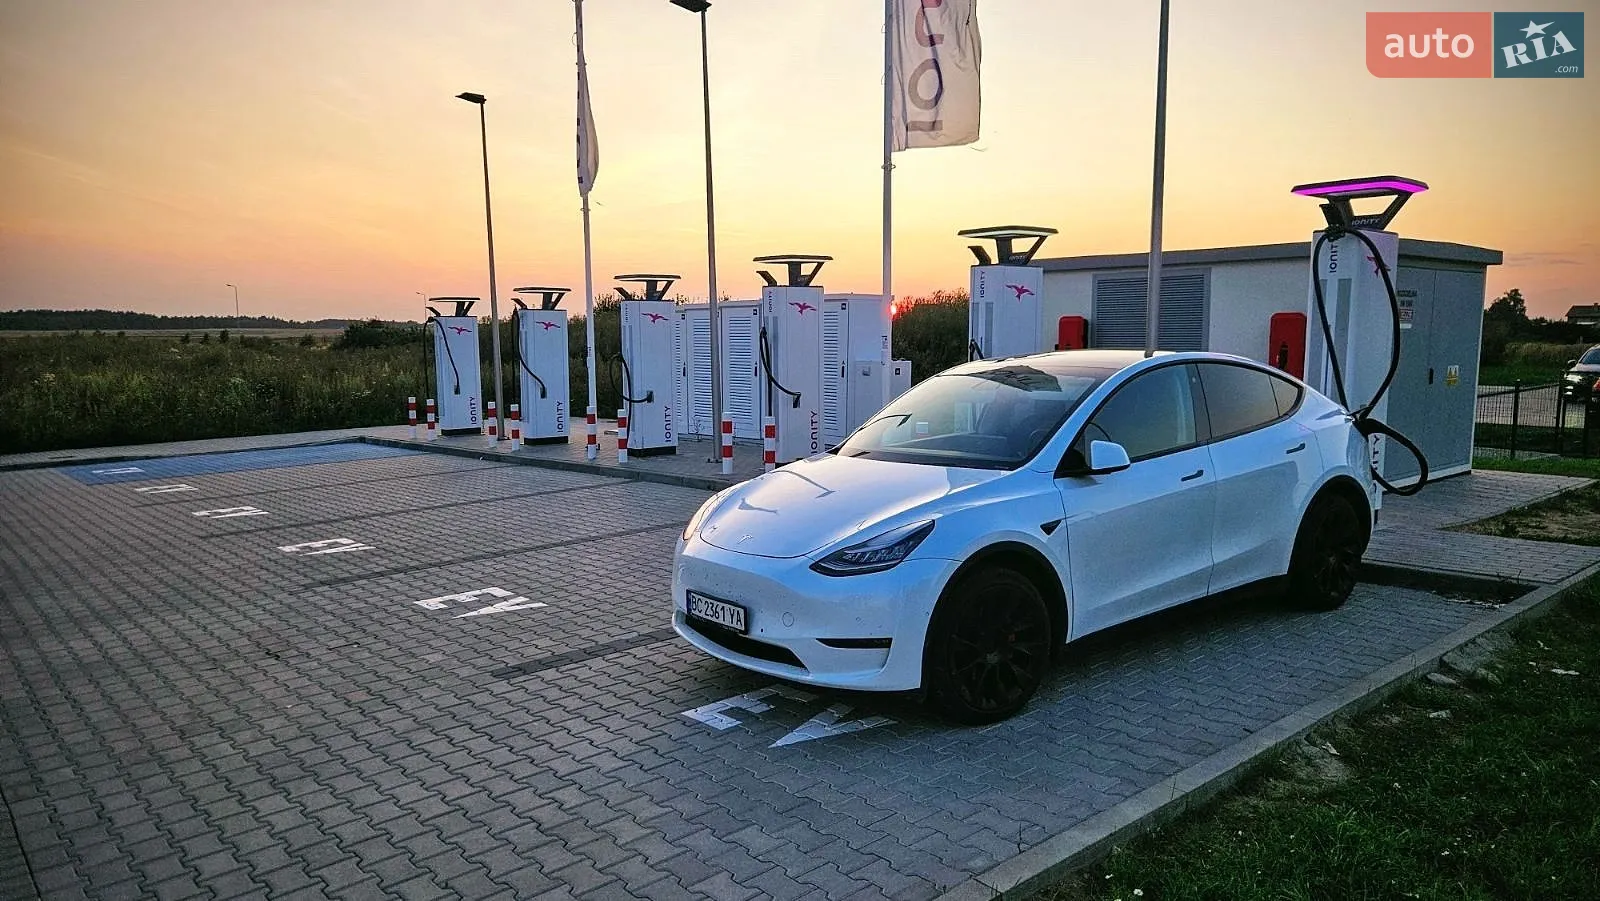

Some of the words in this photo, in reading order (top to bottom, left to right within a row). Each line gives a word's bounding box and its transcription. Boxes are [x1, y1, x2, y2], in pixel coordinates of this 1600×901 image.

[1329, 244, 1338, 273] IONIT
[664, 406, 672, 442] IONITY
[276, 538, 376, 556] EV
[413, 587, 548, 619] EV
[691, 595, 702, 613] BC
[704, 602, 725, 622] 2361
[729, 608, 742, 626] YA
[681, 684, 898, 748] EV
